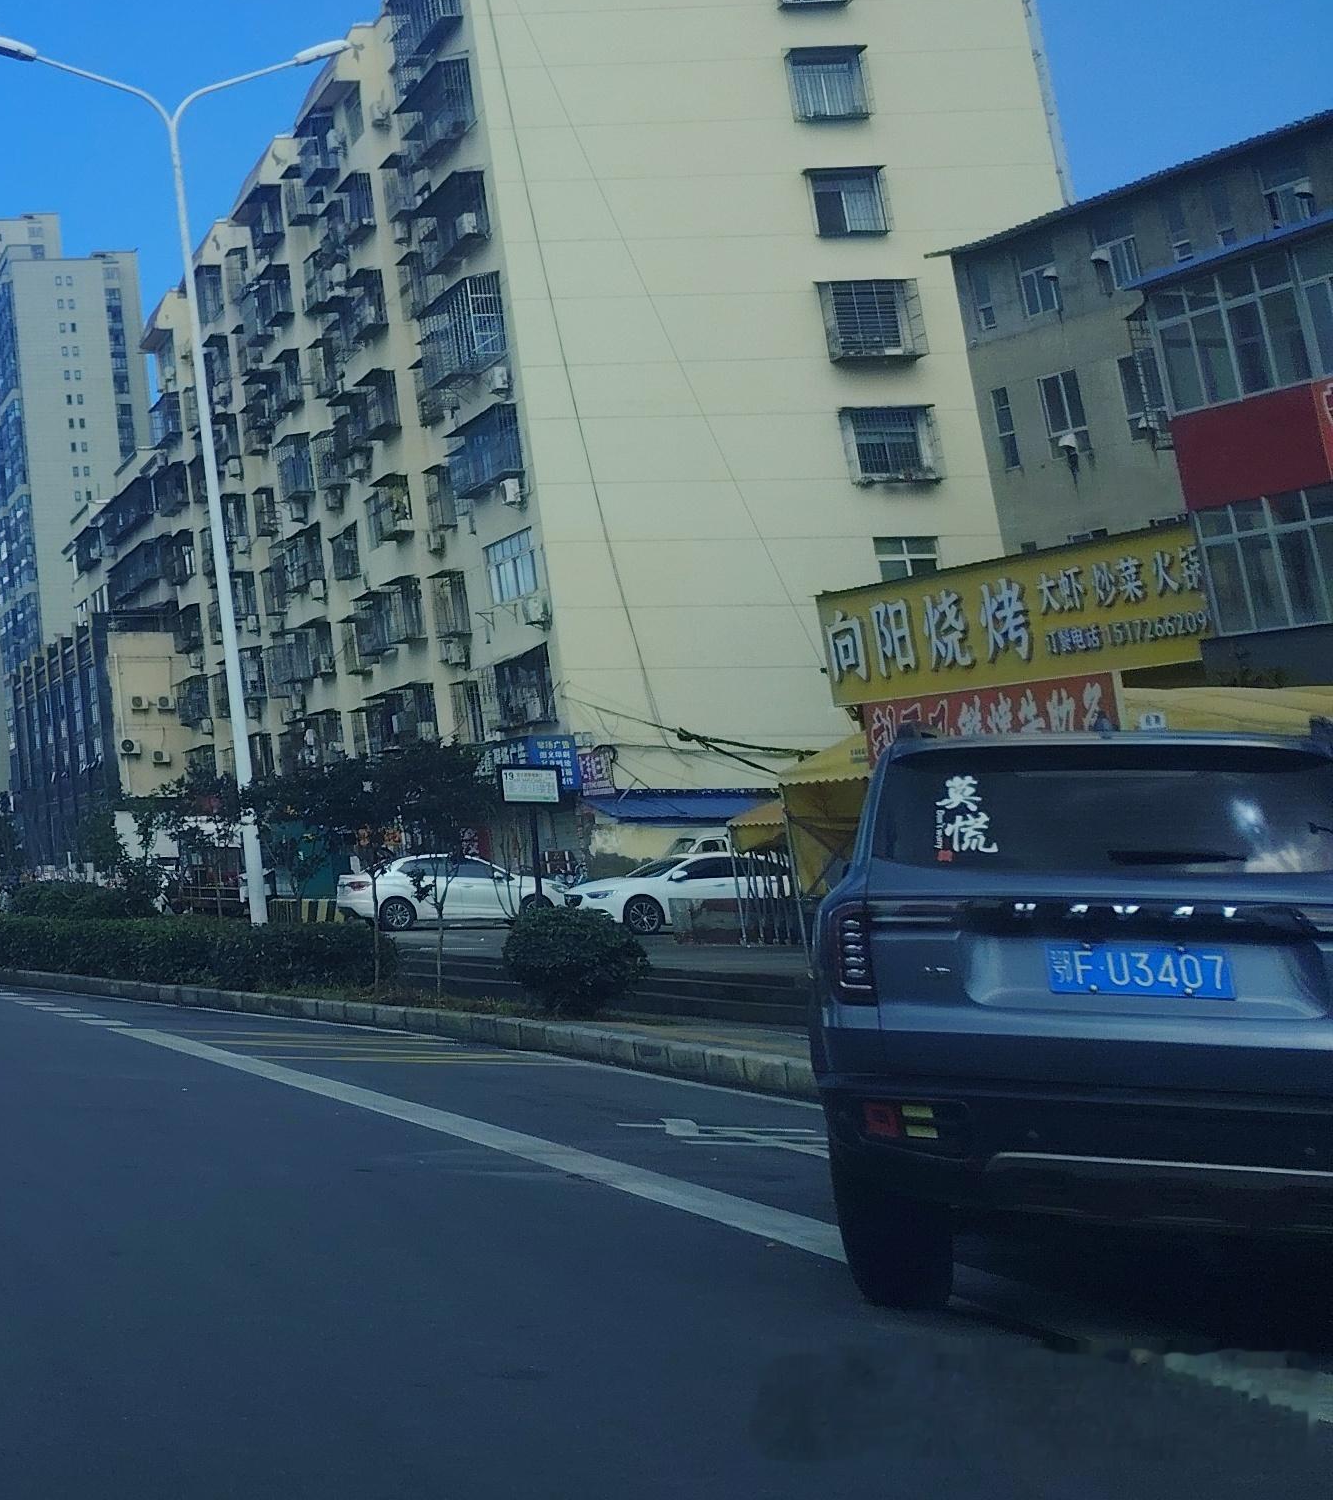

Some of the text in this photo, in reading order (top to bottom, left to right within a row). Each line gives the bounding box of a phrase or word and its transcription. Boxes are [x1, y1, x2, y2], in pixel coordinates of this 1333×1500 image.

[1038, 566, 1084, 612] 大虾
[1092, 556, 1145, 605] 炒菜
[825, 578, 1030, 682] 向阳烧烤
[935, 776, 999, 853] 莫慌
